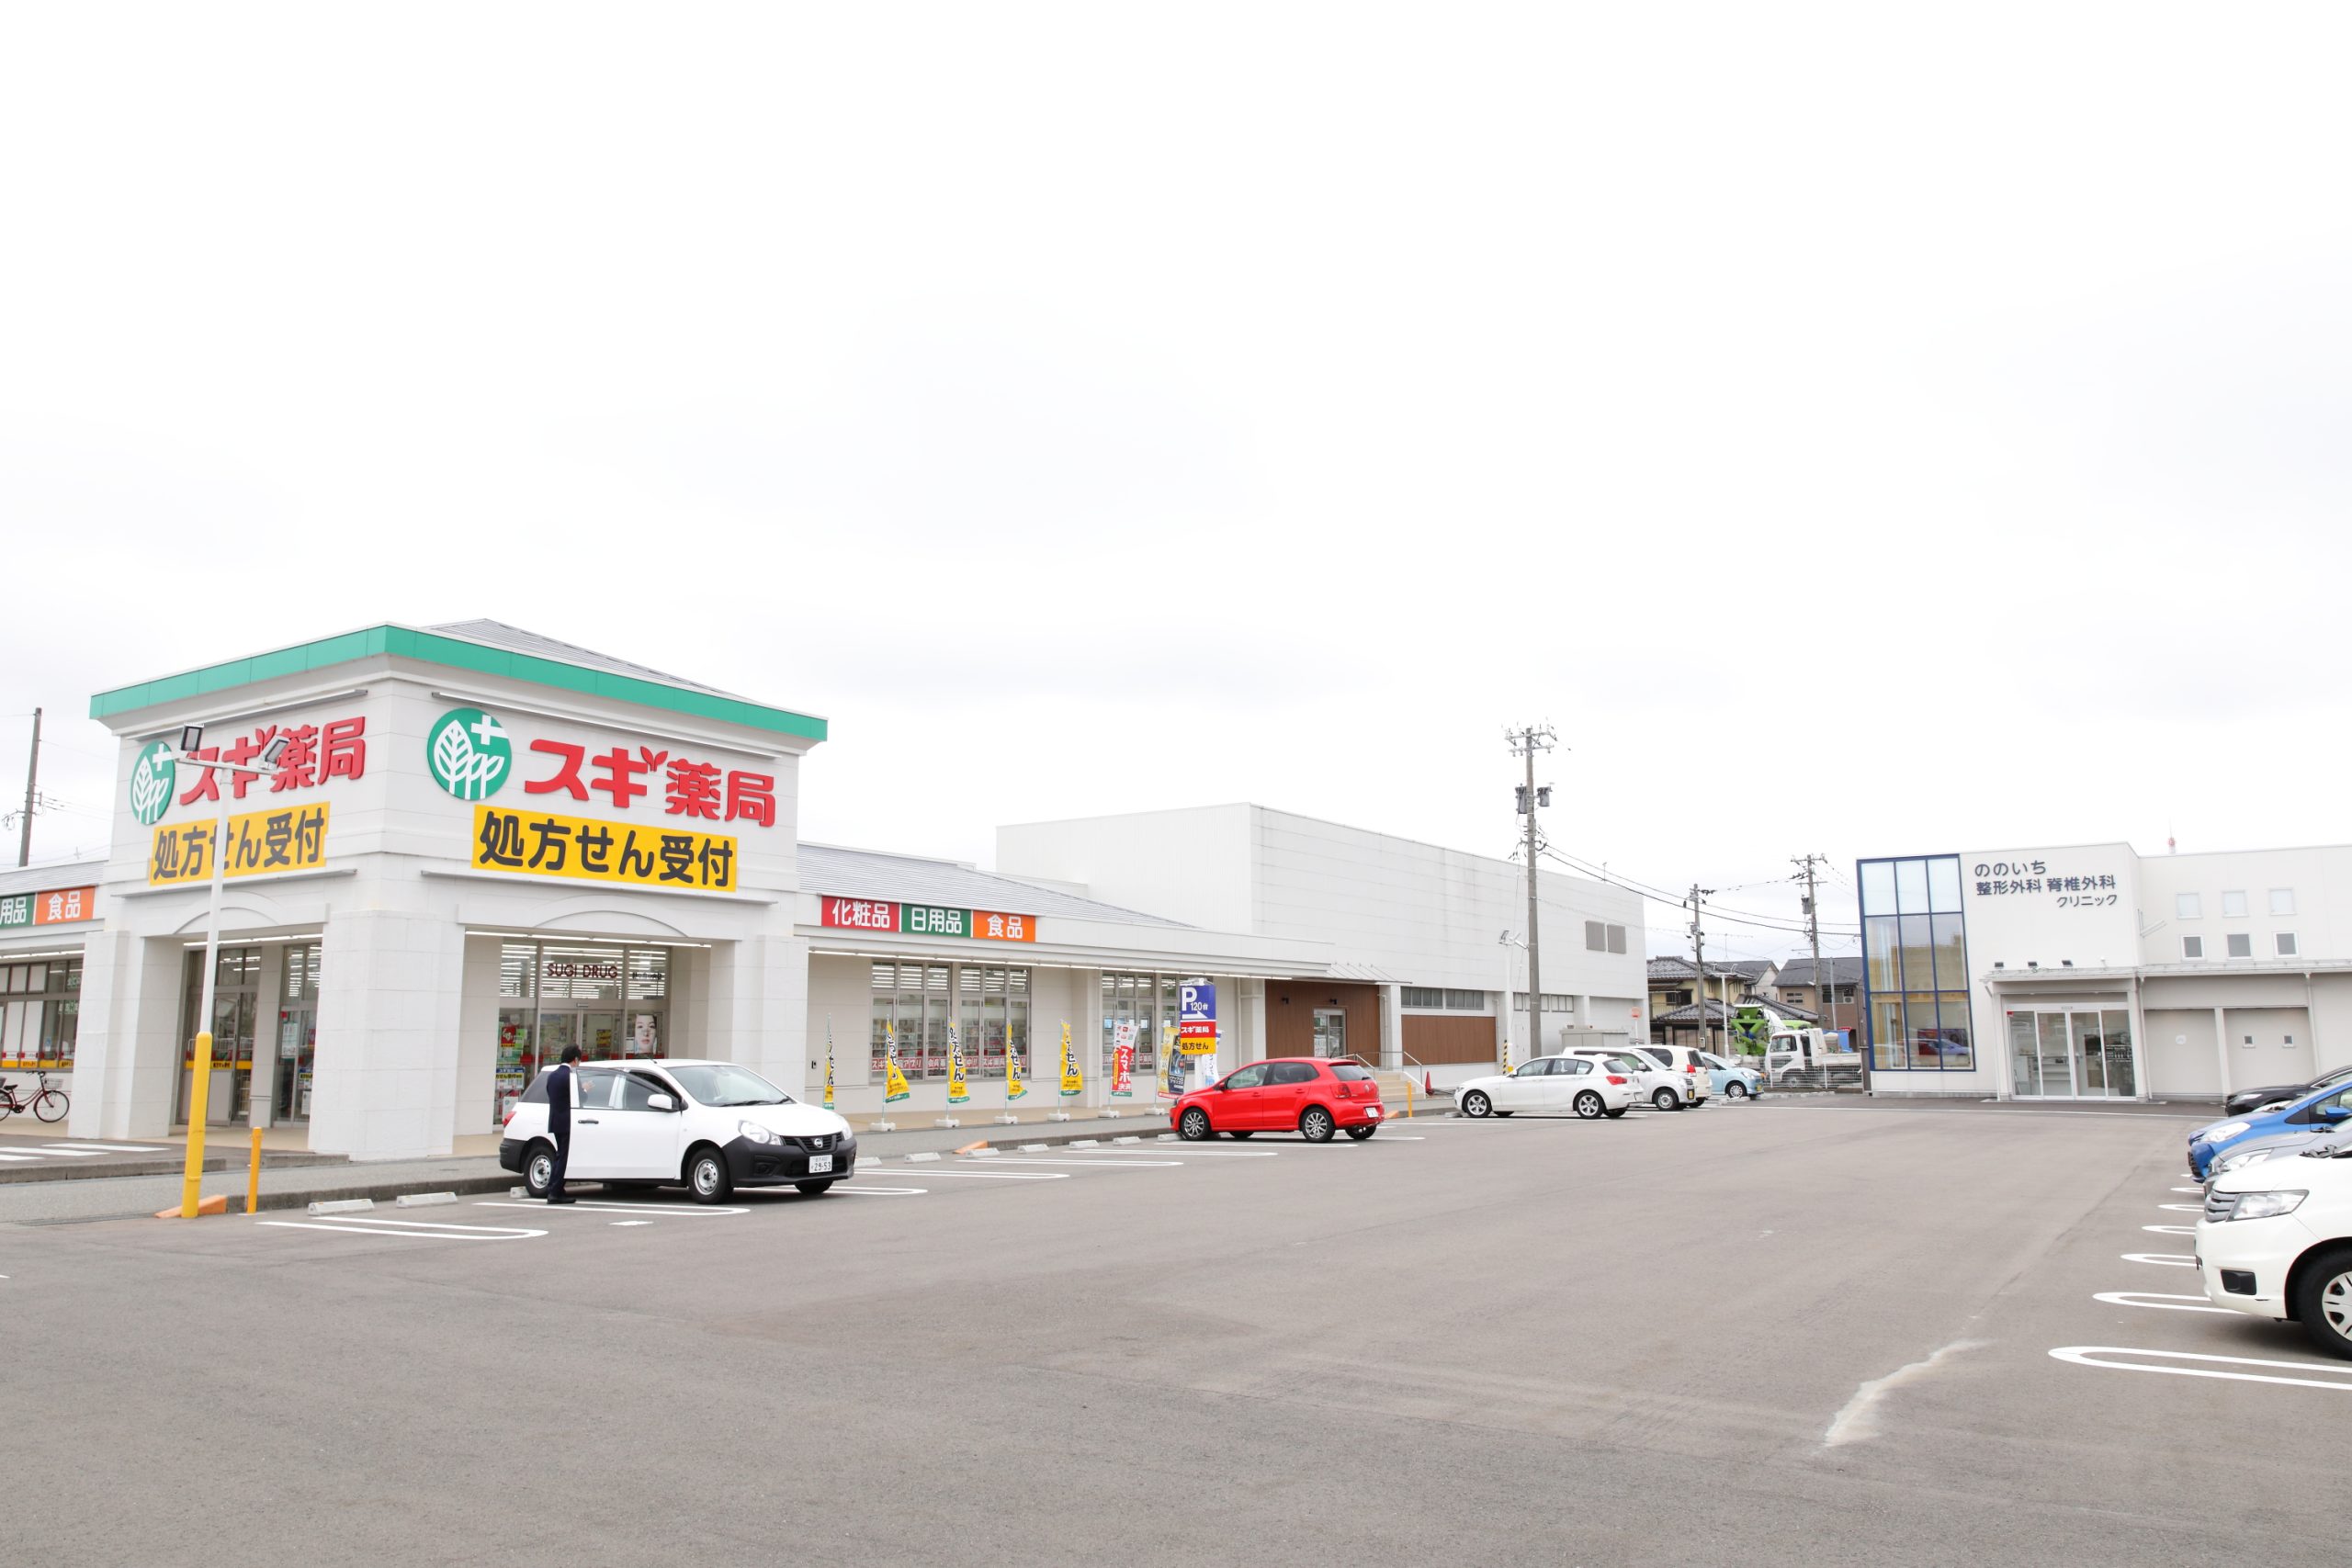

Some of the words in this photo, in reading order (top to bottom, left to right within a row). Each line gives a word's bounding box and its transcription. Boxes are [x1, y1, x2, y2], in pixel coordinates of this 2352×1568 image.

[179, 716, 367, 807] スギ薬局
[525, 739, 776, 828] スギ薬局
[479, 810, 733, 887] 処方せん受付
[1974, 860, 2047, 877] ののいち
[1976, 878, 2041, 896] 整形外科
[2046, 874, 2117, 893] 脊椎外科
[47, 891, 81, 920] 食品
[2056, 894, 2118, 908] クリニック
[831, 899, 890, 929] 化粧品
[911, 907, 962, 934] 日用品
[987, 914, 1023, 939] 食品
[547, 963, 577, 978] SUGI
[582, 964, 618, 978] DRUG
[1182, 987, 1197, 1011] P
[1191, 1002, 1208, 1011] 120台
[1182, 1042, 1209, 1051] 処方せん
[1119, 1048, 1131, 1083] スマホ
